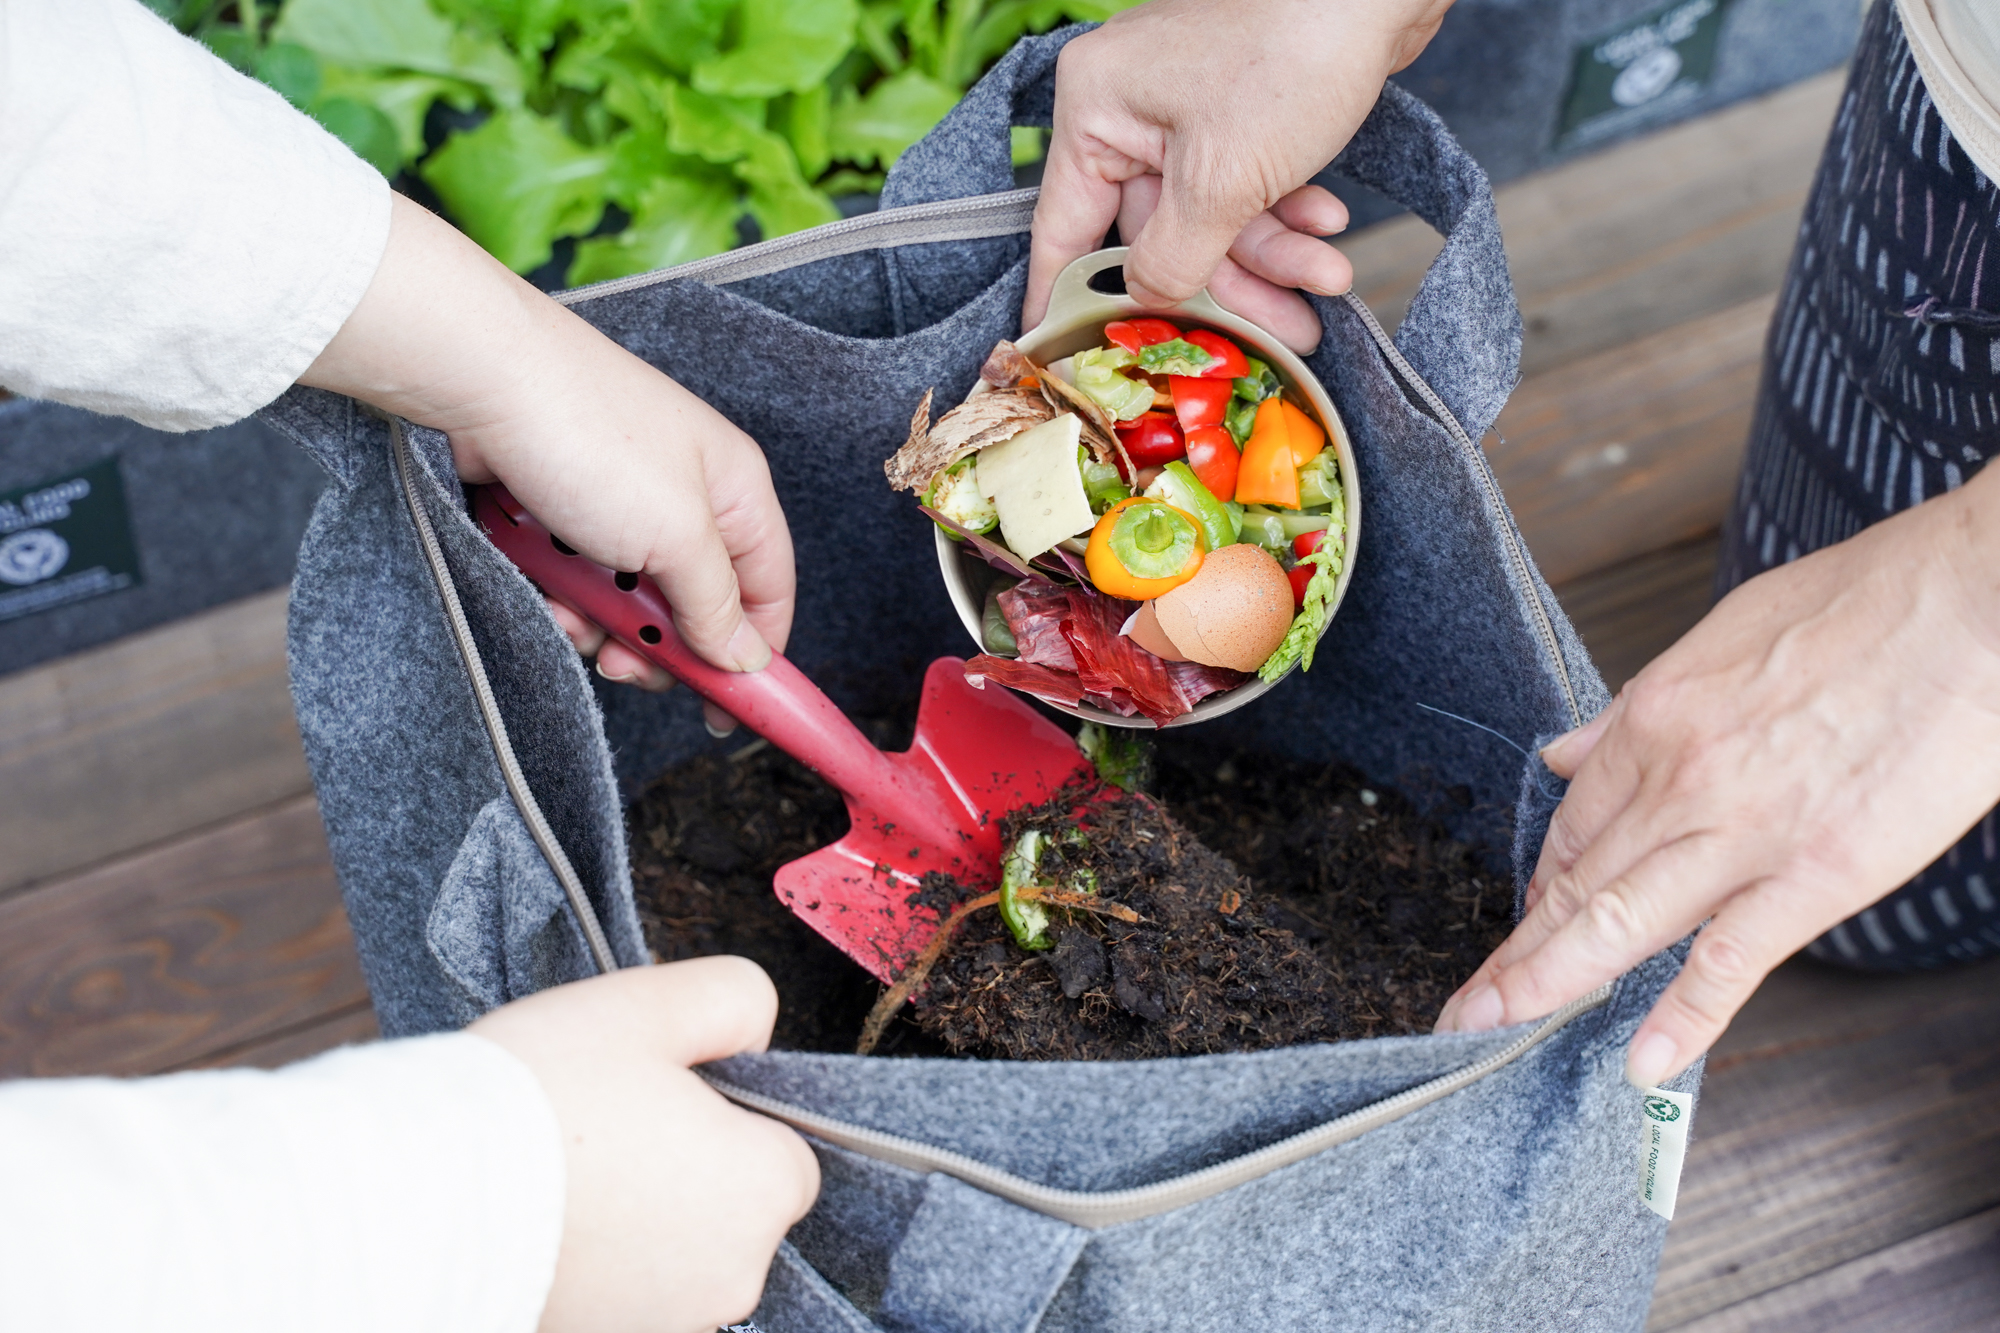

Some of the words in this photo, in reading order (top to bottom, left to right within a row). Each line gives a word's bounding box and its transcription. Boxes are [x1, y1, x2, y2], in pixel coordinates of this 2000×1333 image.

[1652, 1124, 1661, 1145] LOCAL
[1647, 1147, 1659, 1170] FOOD
[1644, 1170, 1655, 1201] CYCLING
